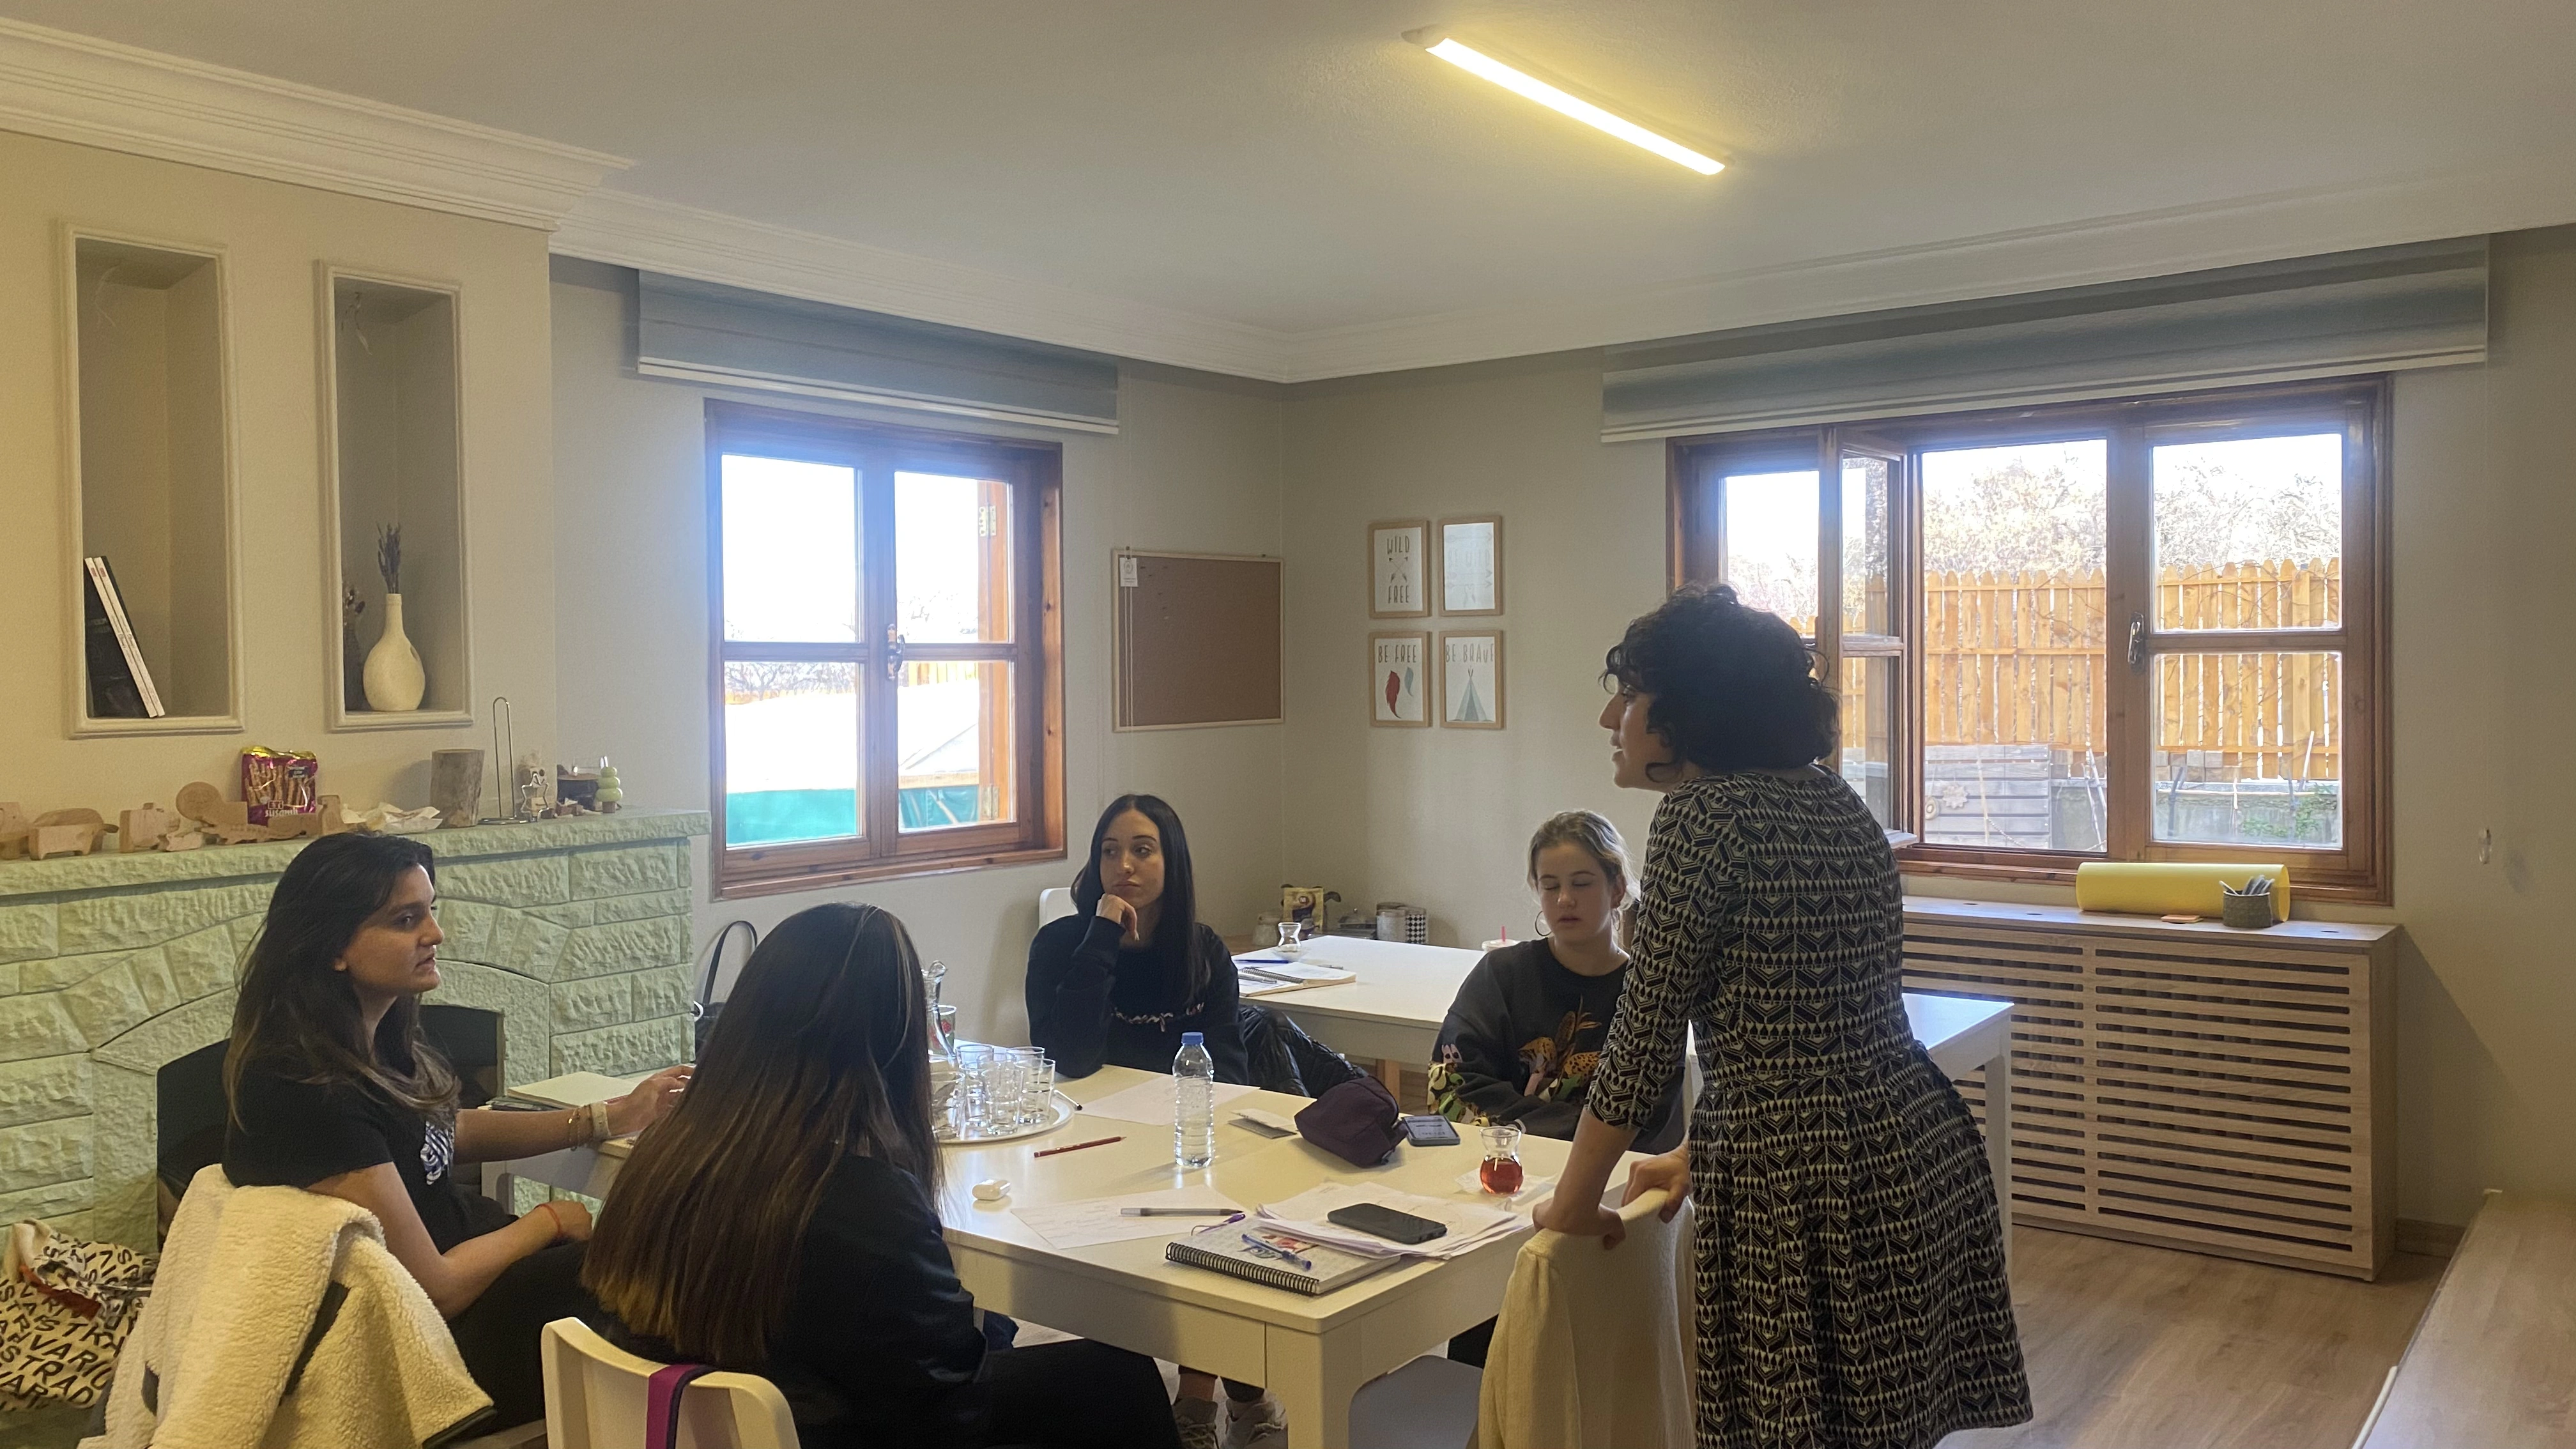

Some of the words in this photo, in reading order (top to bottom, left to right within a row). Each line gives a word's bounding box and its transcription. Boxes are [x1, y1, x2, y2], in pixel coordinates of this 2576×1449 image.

[1386, 535, 1410, 555] WILD
[1388, 585, 1410, 604] FREE
[1378, 645, 1388, 663] BE
[1395, 644, 1416, 663] FREE
[1446, 643, 1455, 663] BE
